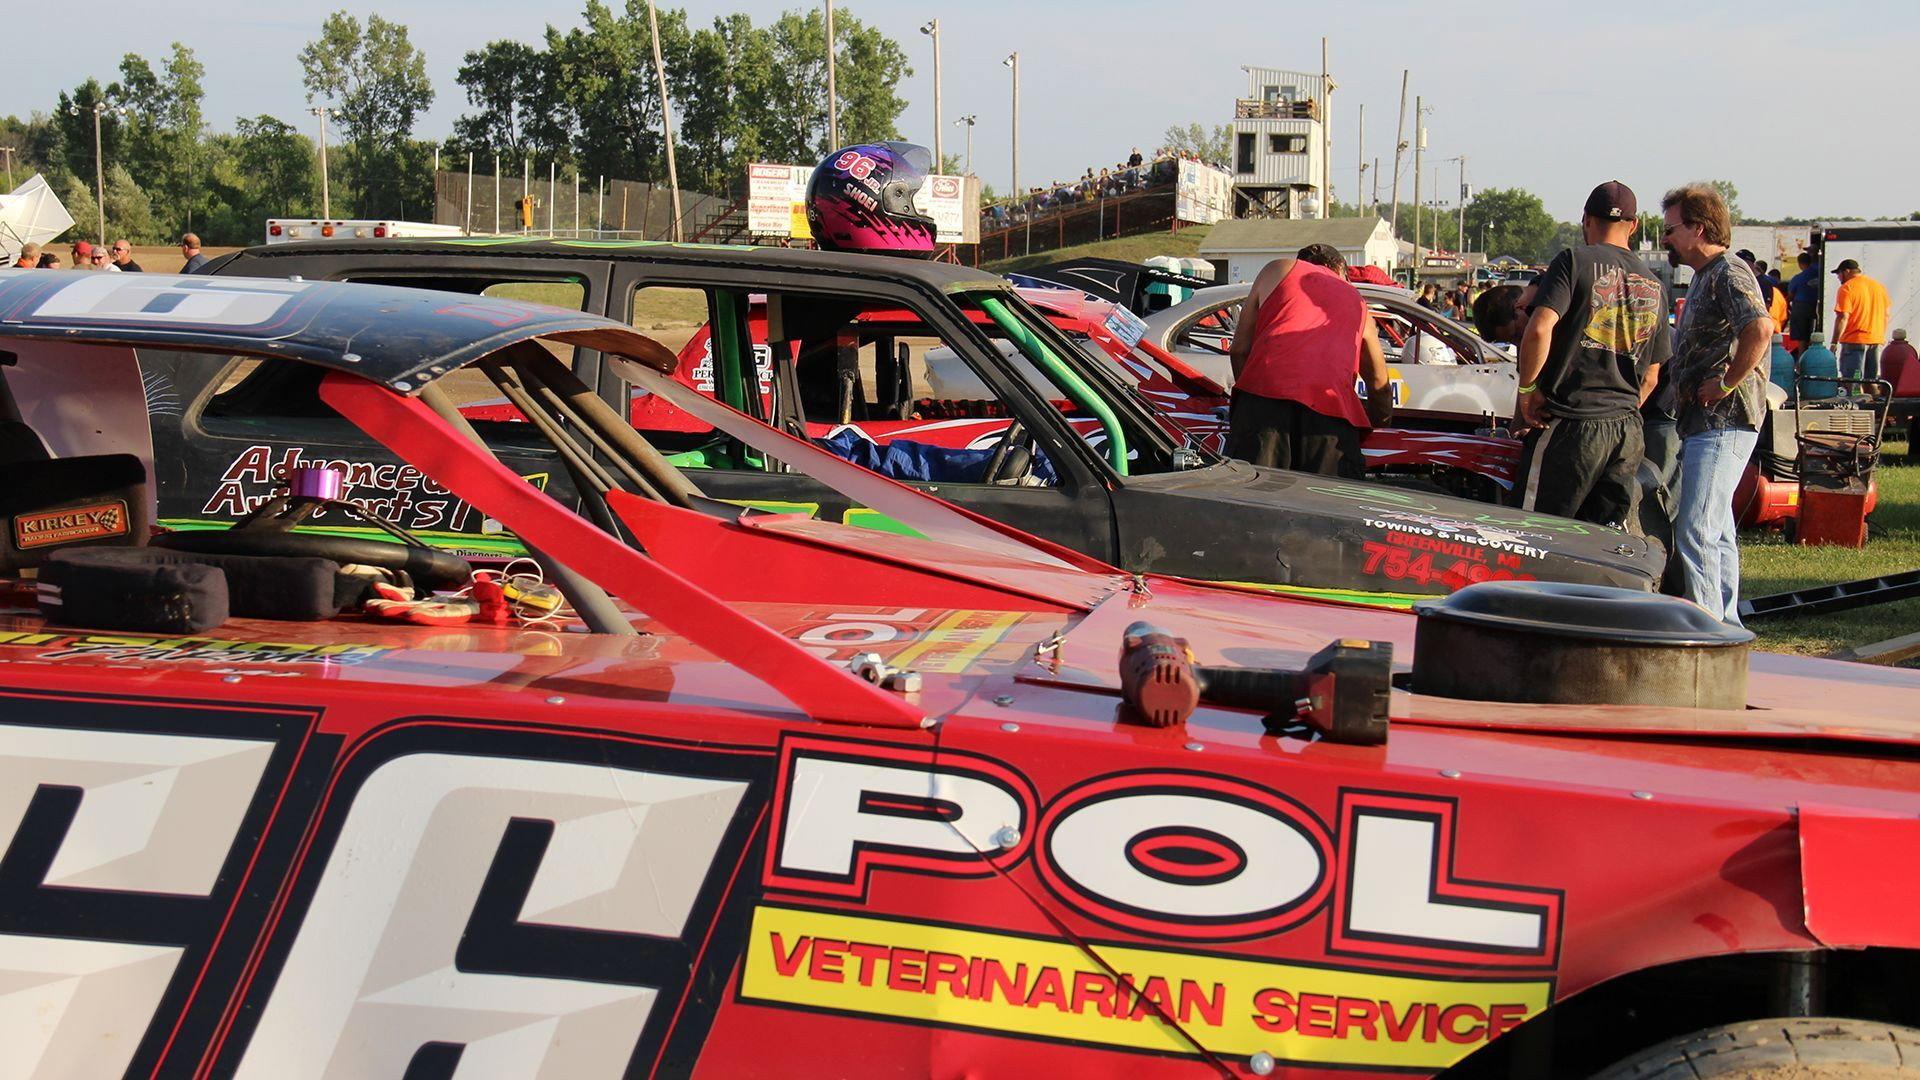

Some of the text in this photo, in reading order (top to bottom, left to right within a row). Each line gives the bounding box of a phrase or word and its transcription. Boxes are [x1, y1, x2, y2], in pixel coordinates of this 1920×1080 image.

[834, 150, 876, 181] 96
[842, 182, 879, 213] SHOEI
[23, 511, 102, 534] KIRKEY
[1363, 518, 1435, 536] TOWING
[1438, 530, 1450, 539] &
[1455, 534, 1550, 560] RECOVERY
[1497, 553, 1522, 569] MI
[779, 757, 1542, 948] POL
[769, 931, 1529, 1044] VETERINARIAN SERVICE
